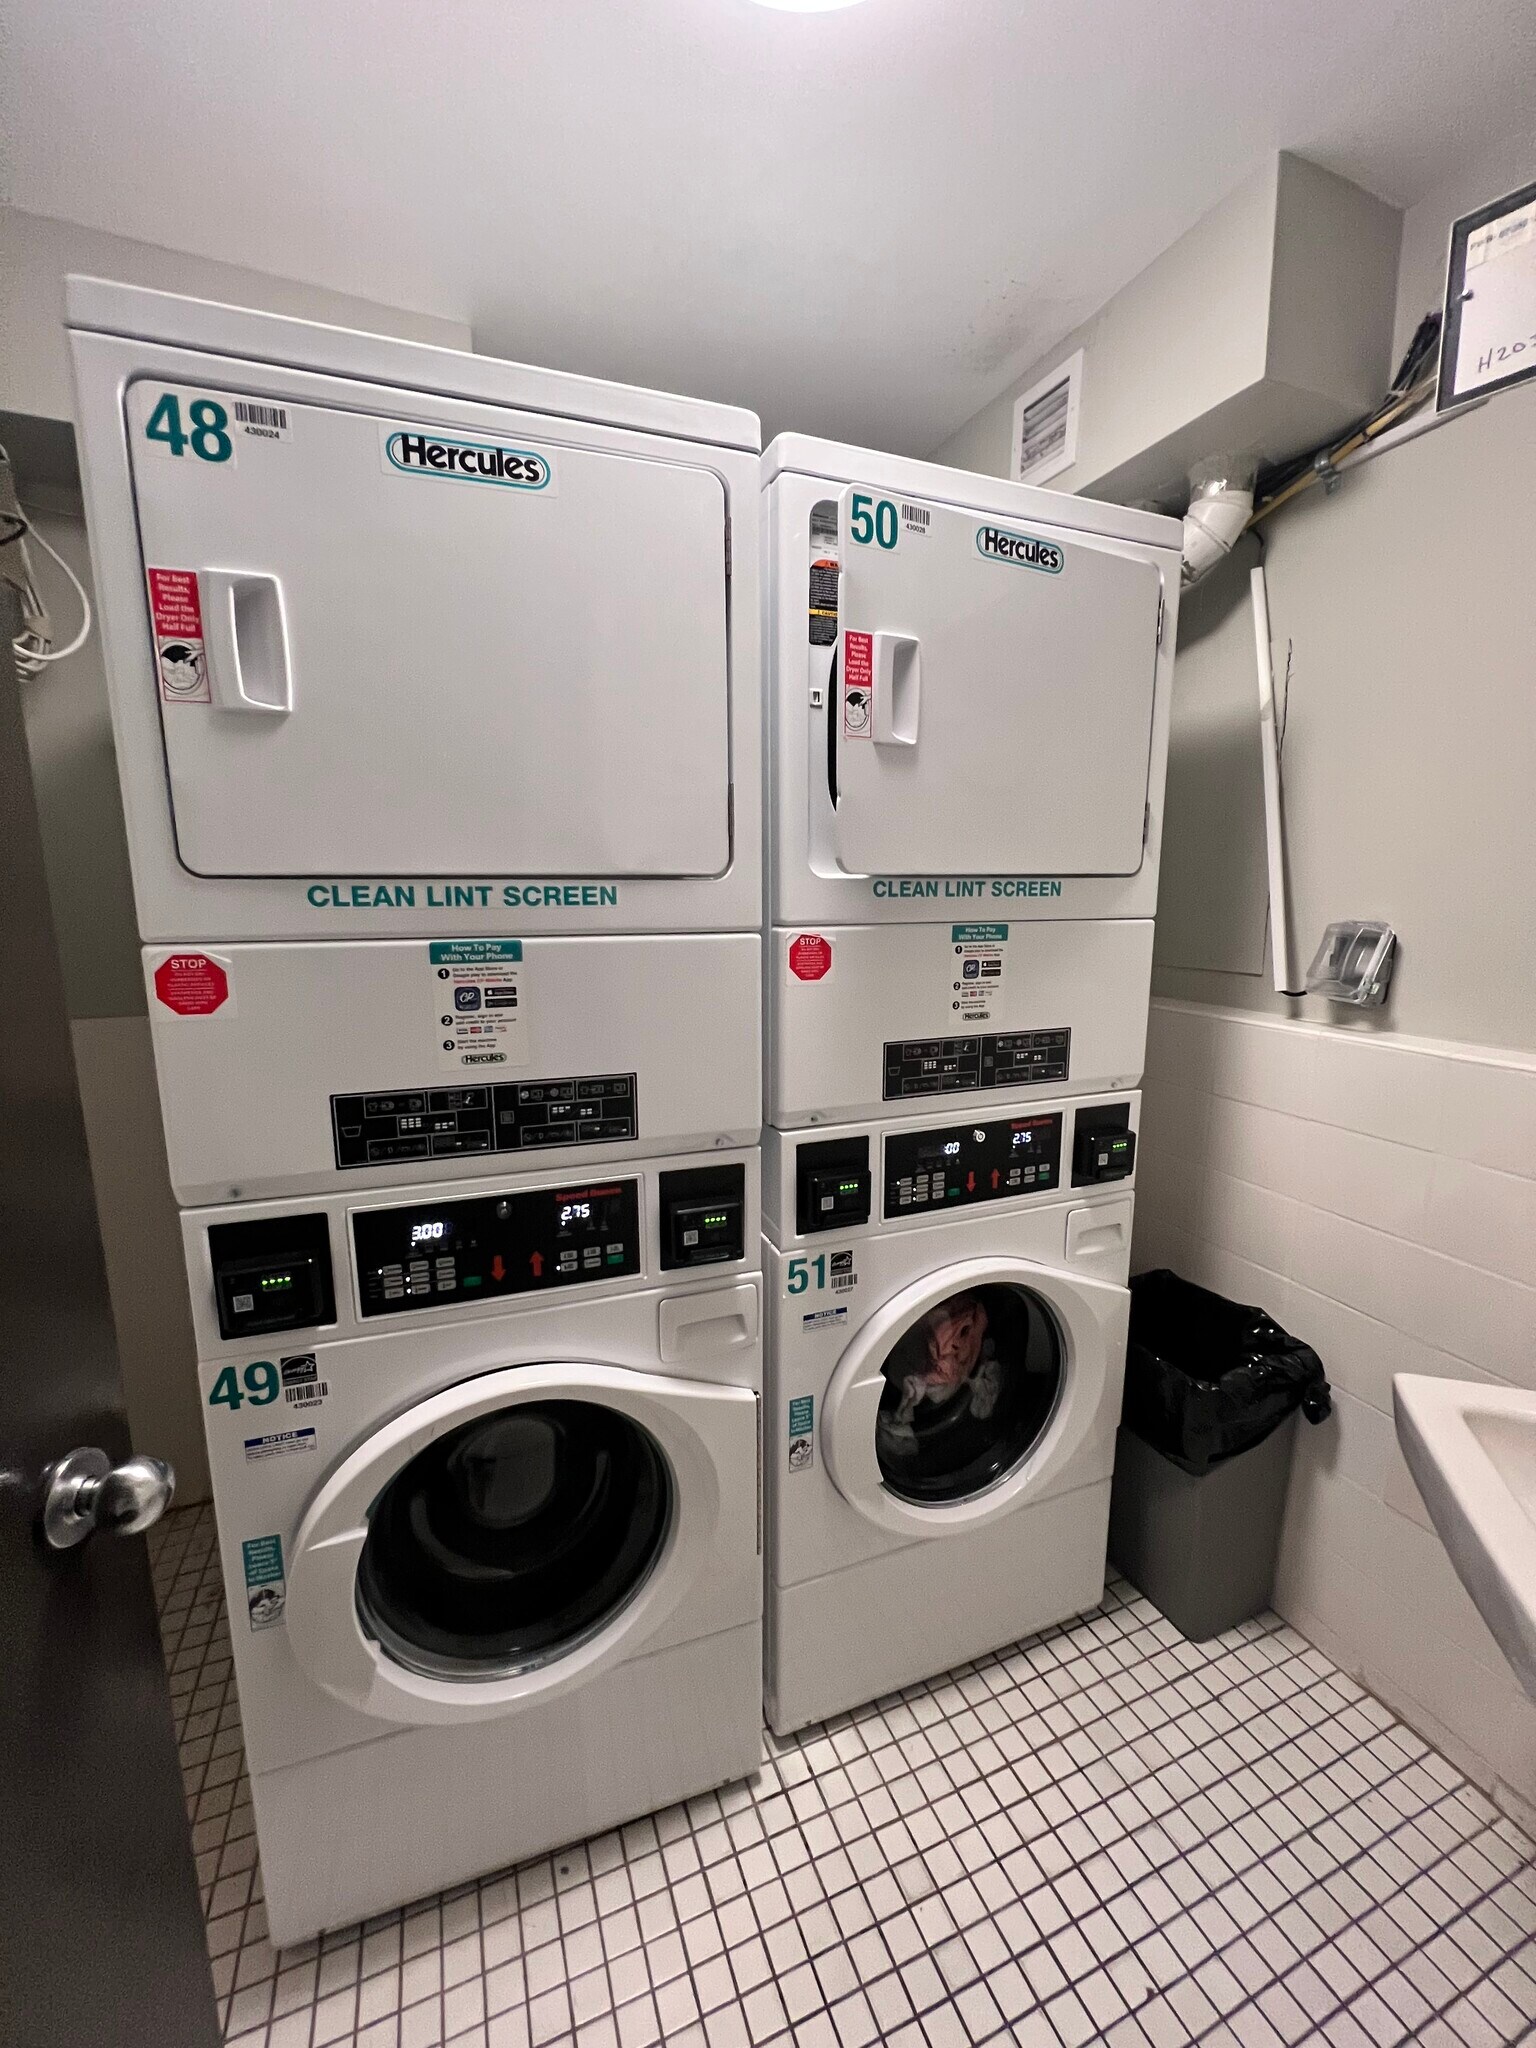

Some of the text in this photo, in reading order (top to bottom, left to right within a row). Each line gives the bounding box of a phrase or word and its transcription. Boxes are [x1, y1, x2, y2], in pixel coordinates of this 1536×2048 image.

[146, 393, 232, 462] 48
[244, 426, 280, 439] 430024
[401, 434, 540, 482] Hercules
[851, 493, 898, 550] 50
[985, 528, 1058, 568] Hercules
[156, 573, 190, 584] For Best
[162, 593, 188, 602] Please
[158, 602, 180, 612] Load
[156, 612, 199, 624] Dryer Only
[162, 622, 196, 632] Half Full
[873, 880, 1061, 898] CLEAN LINT SCREEN
[307, 886, 618, 907] CLEAN LINT SCREEN
[452, 944, 472, 952] How
[486, 943, 502, 952] Pay
[171, 959, 206, 969] STOP
[466, 1054, 504, 1063] Hercules
[788, 1254, 825, 1294] 51
[209, 1361, 279, 1410] 49
[262, 1432, 298, 1443] NOTICE
